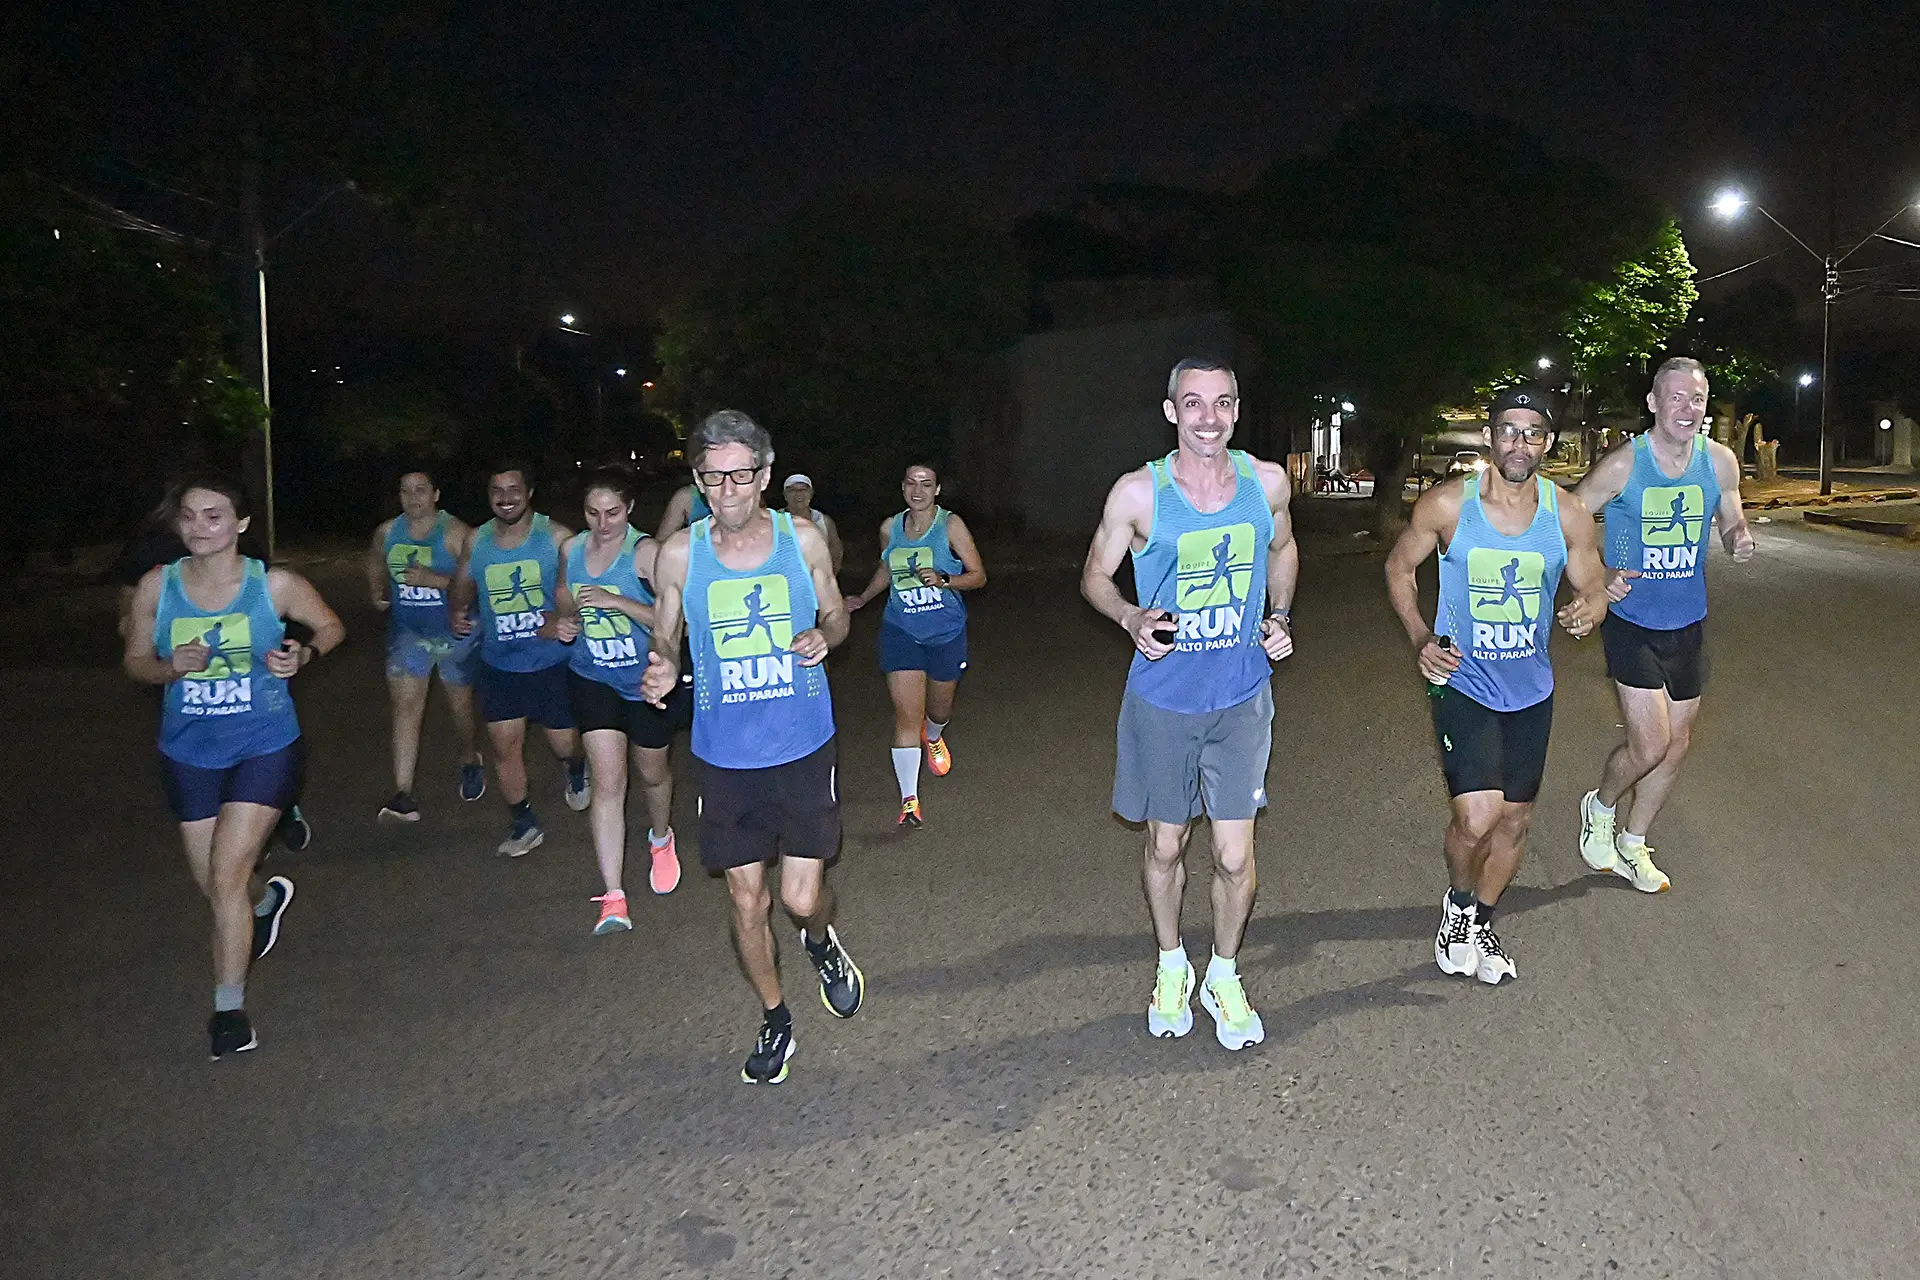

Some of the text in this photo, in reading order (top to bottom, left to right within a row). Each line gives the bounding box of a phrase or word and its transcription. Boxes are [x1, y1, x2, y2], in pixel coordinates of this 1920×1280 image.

[1181, 561, 1211, 570] EQUIPE
[1642, 546, 1698, 570] RUN
[1472, 576, 1500, 585] EQUIPE
[1641, 571, 1664, 580] ALTO
[897, 585, 942, 607] RUN
[495, 609, 545, 633] RUN
[1176, 605, 1246, 640] RUN
[1472, 621, 1537, 650] RUN
[1174, 642, 1203, 652] ALTO
[1472, 649, 1498, 661] ALTO
[720, 654, 794, 691] RUN
[182, 677, 252, 705] RUN
[722, 692, 747, 704] ALTO
